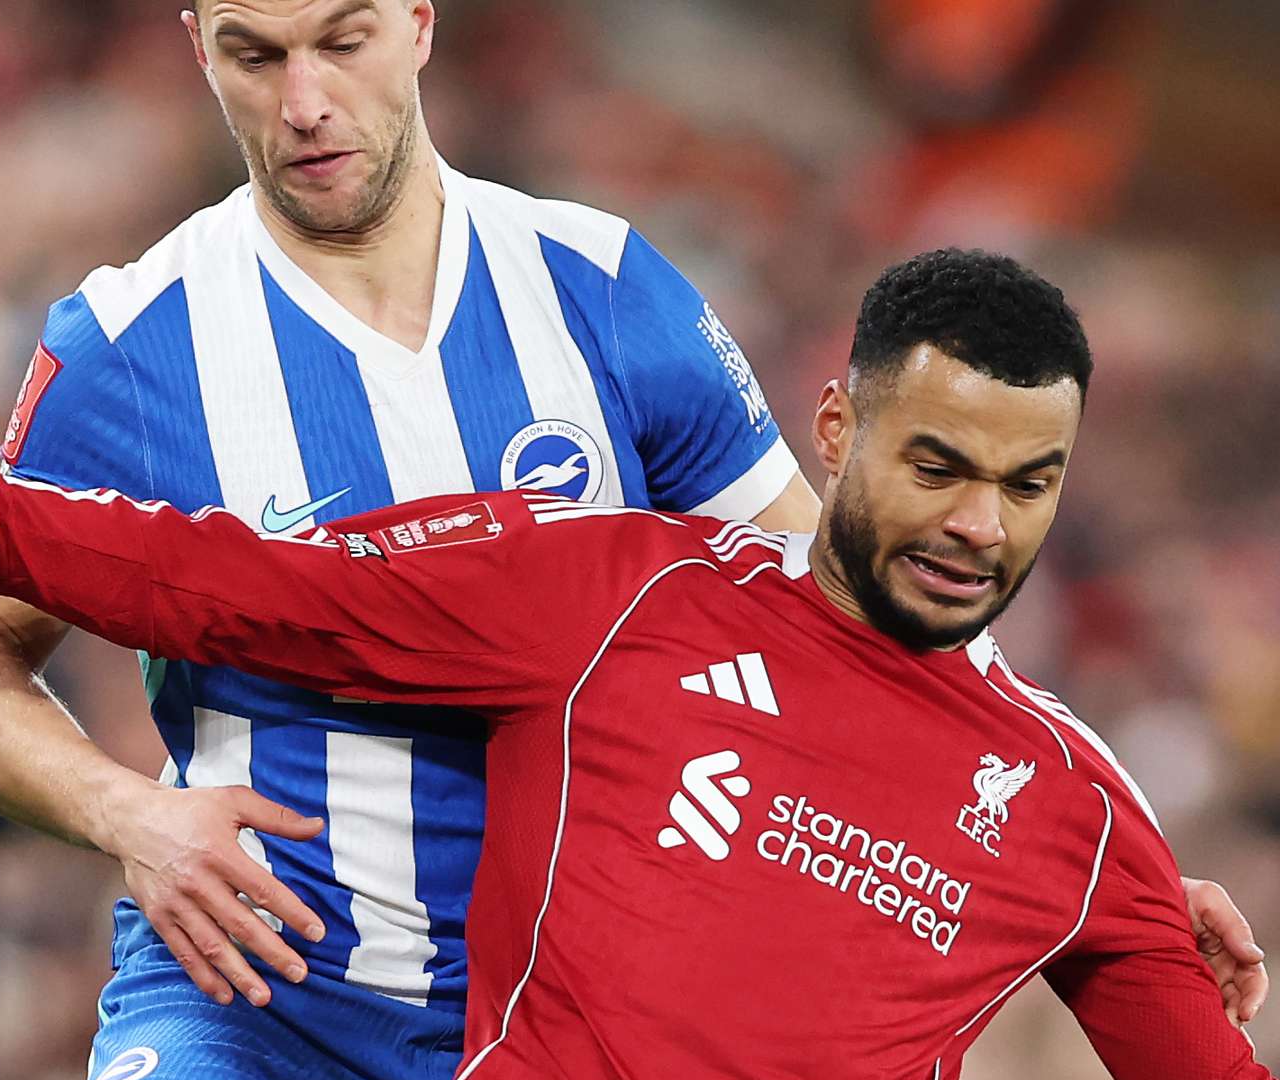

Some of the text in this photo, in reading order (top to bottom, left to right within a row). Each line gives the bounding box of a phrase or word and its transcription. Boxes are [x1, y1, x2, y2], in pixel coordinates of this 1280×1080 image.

[505, 423, 584, 464] BRIGHTON & HOVE
[756, 830, 962, 957] chartered
[768, 794, 972, 916] standard
